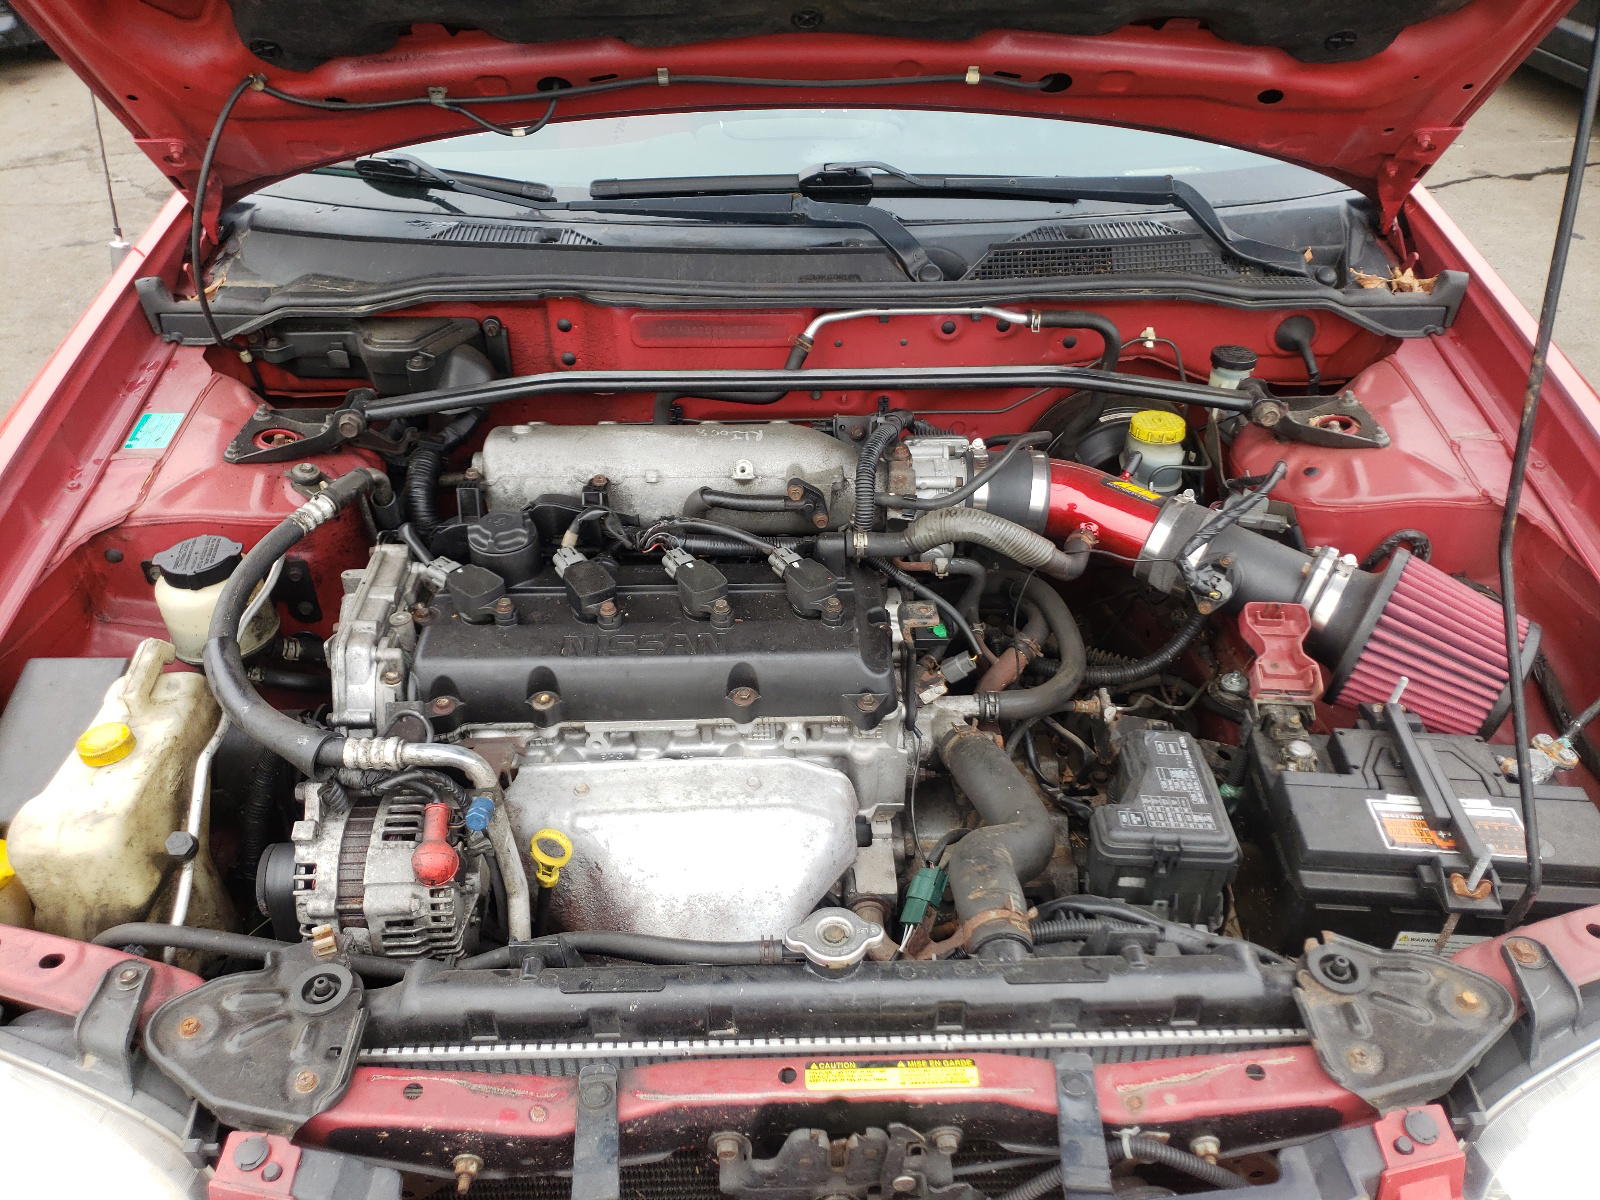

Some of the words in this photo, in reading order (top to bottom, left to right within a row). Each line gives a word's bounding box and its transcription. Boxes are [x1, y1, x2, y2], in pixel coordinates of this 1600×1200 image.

[561, 632, 727, 656] NISSAN
[819, 1061, 856, 1069] CAUTION
[907, 1060, 927, 1068] MISE
[943, 1059, 973, 1067] GARDE
